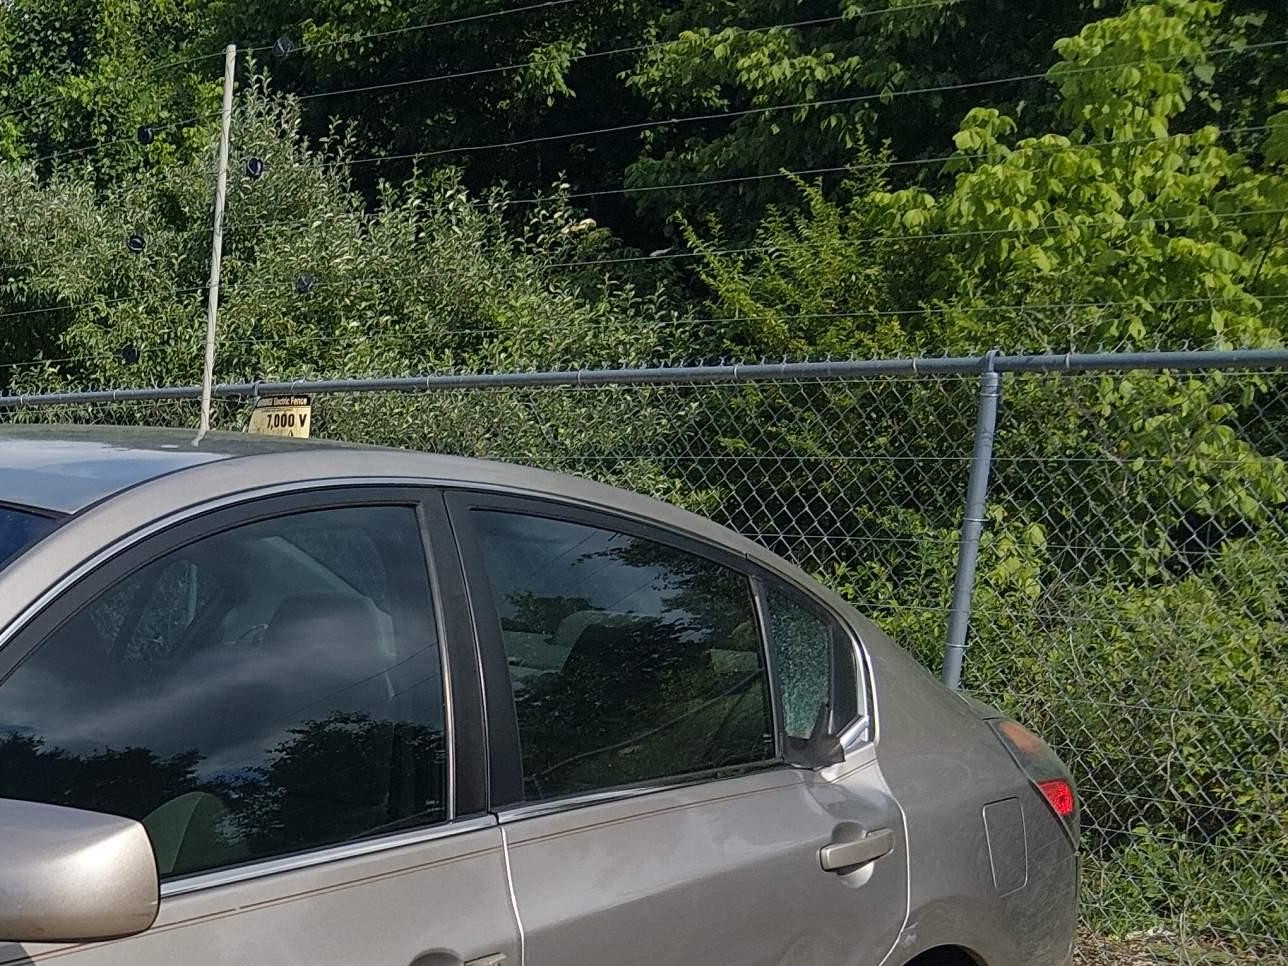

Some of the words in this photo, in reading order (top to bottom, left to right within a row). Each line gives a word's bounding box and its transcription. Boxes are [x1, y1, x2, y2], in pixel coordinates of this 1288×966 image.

[290, 396, 308, 405] Fence
[267, 413, 295, 430] 7,000
[298, 413, 308, 428] V
